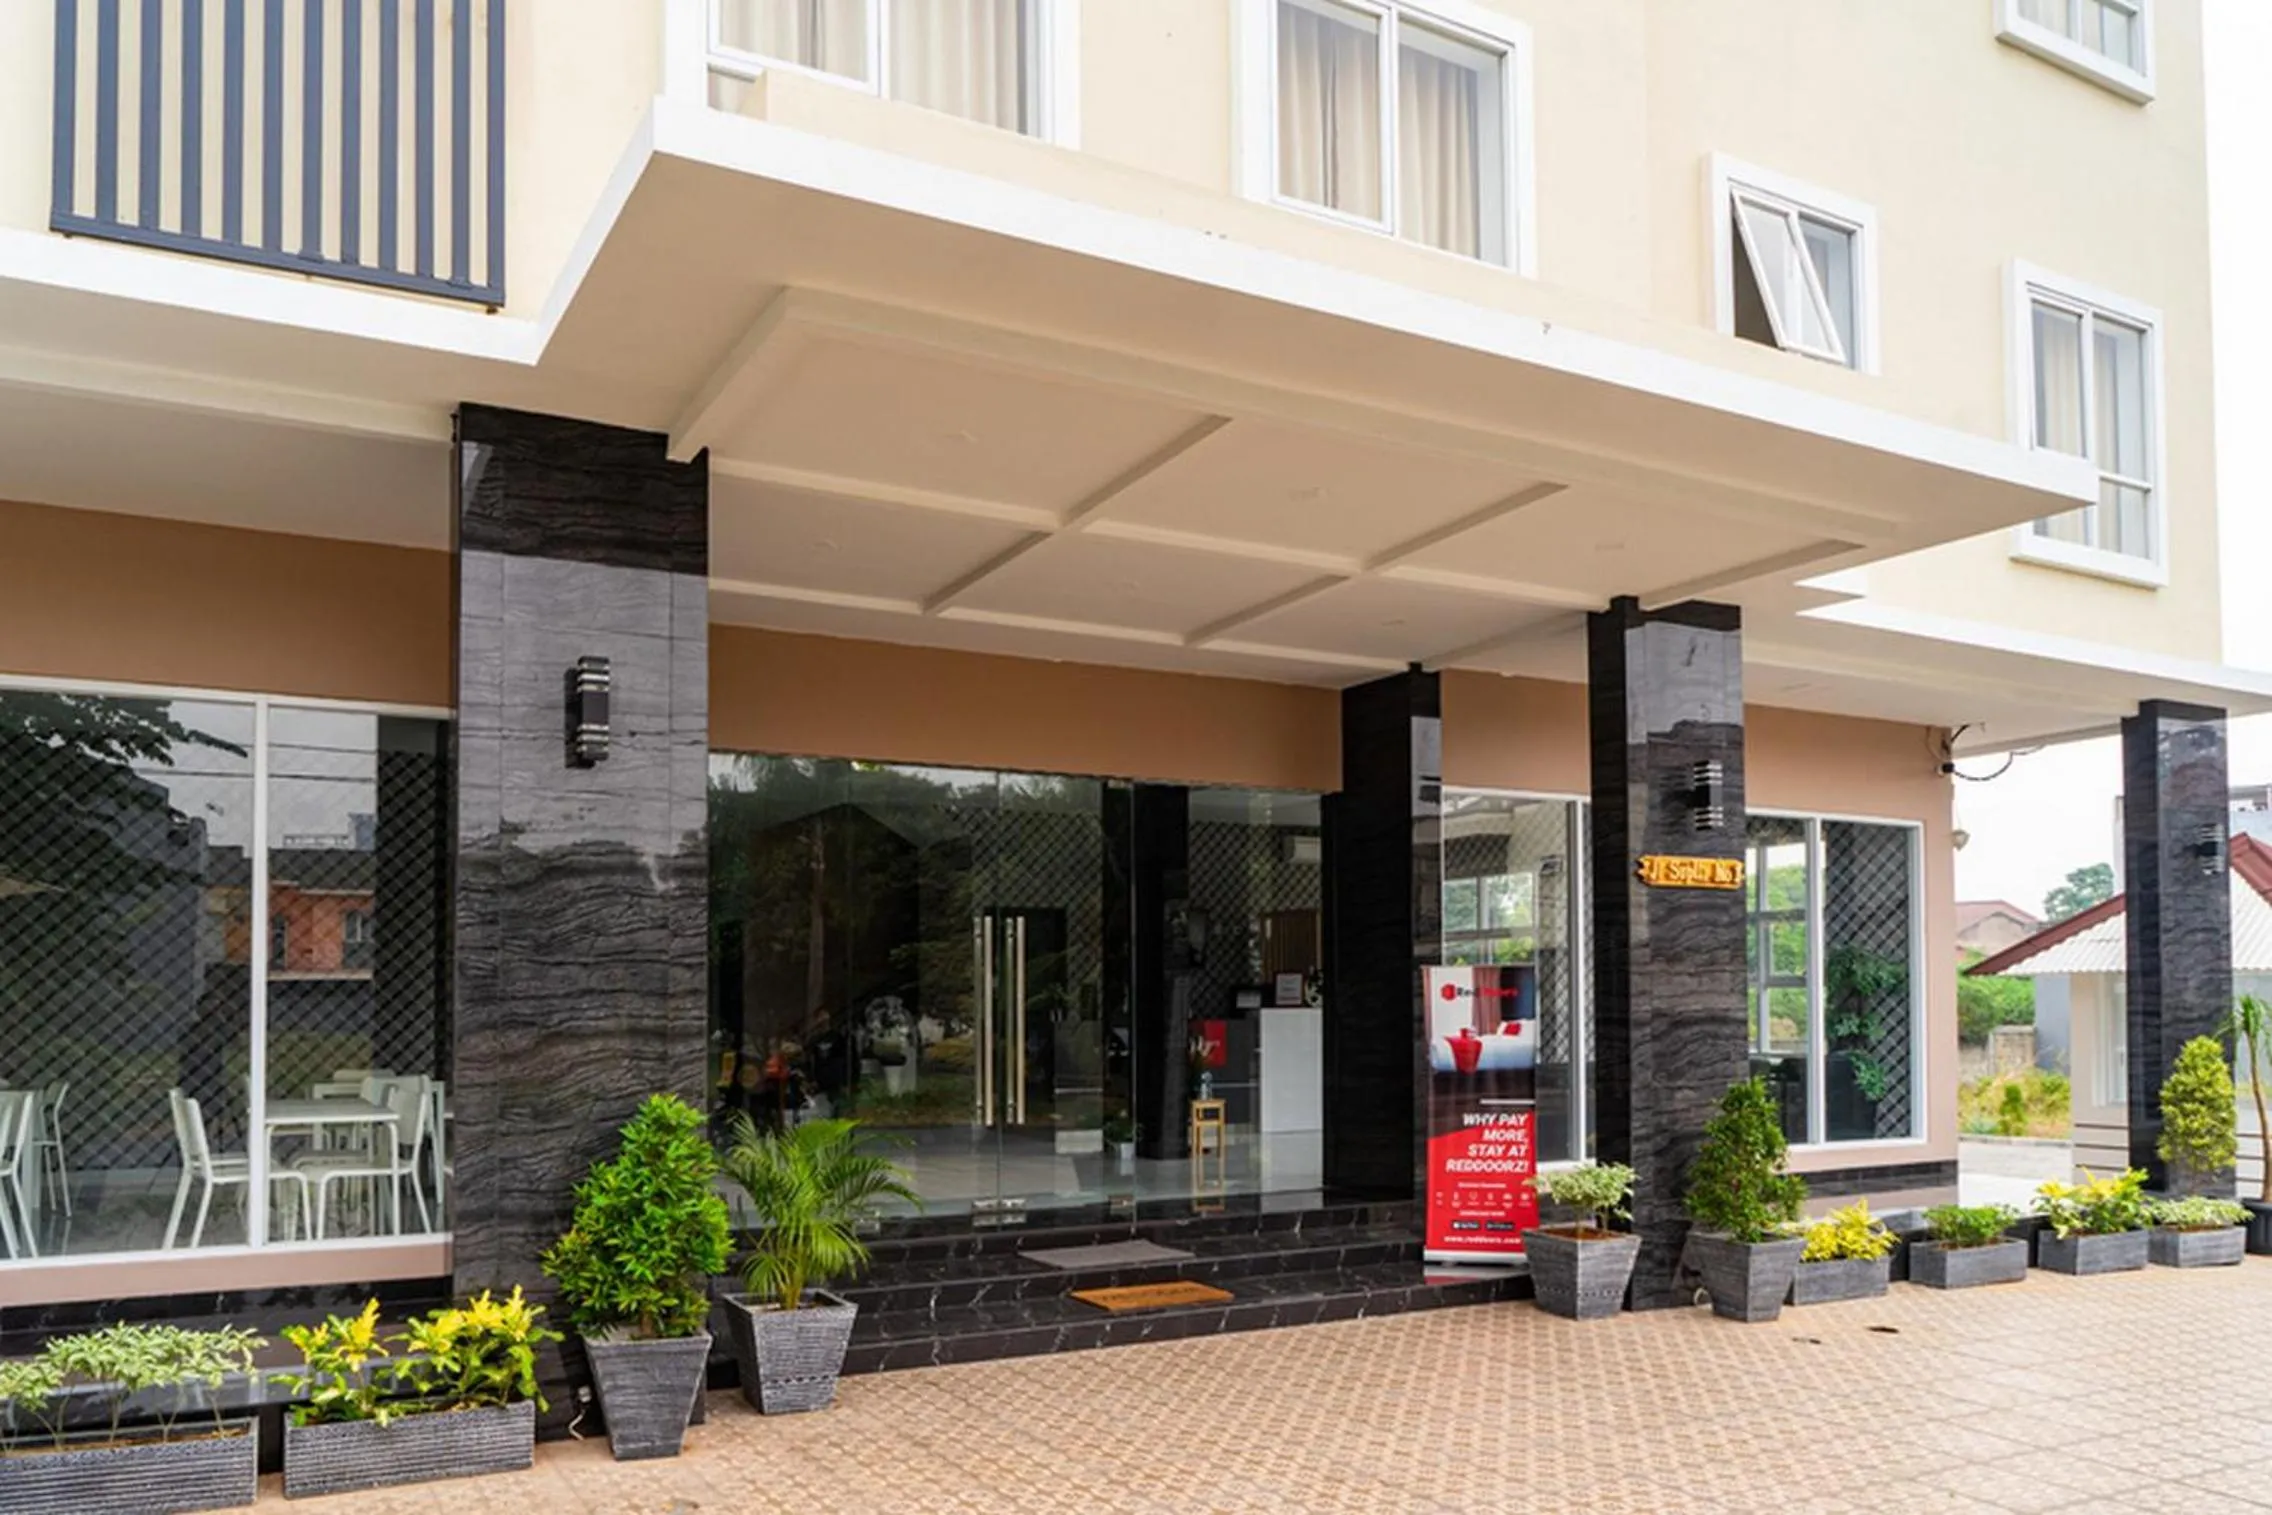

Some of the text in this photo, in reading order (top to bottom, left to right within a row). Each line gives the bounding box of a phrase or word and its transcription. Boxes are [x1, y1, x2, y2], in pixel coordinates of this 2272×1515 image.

[1463, 1113, 1529, 1126] WHY PAY
[1467, 1143, 1529, 1157] STAY AT
